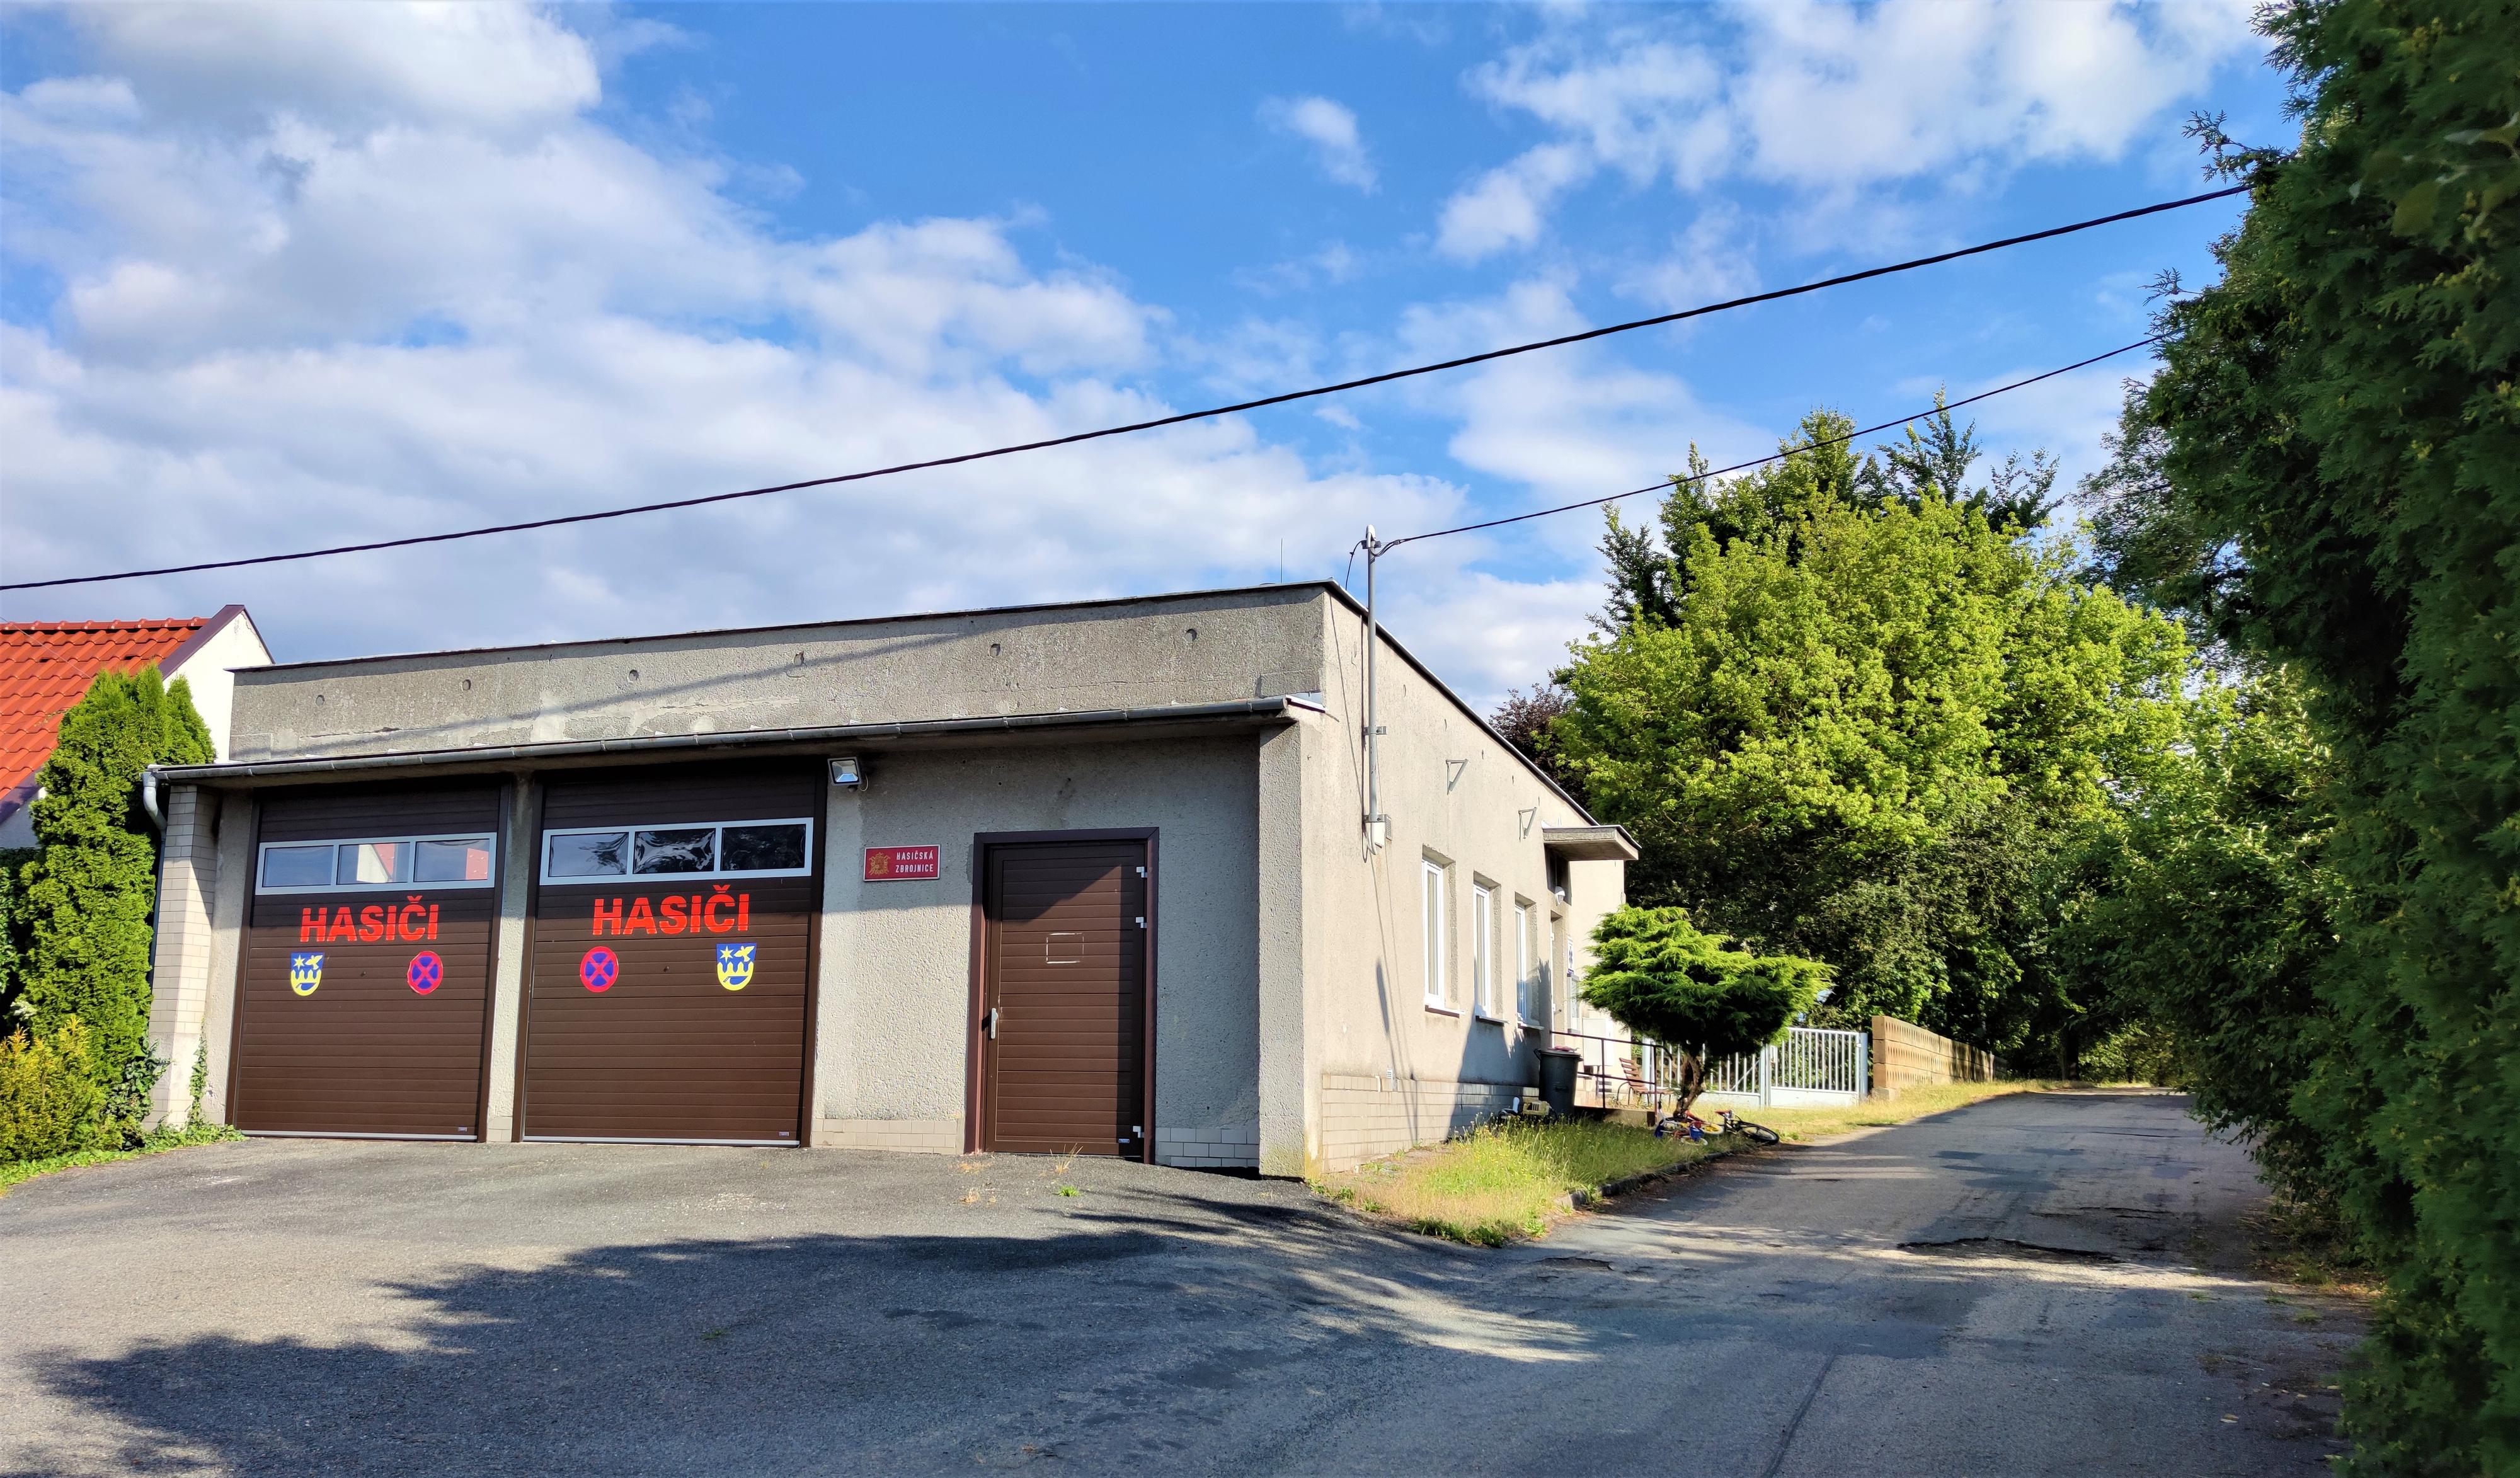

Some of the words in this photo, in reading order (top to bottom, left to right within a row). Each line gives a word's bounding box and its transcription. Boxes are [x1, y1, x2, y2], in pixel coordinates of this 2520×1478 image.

[895, 864, 934, 873] ZBROJNICE
[896, 850, 933, 860] HASIČSKÁ
[299, 895, 439, 942] HASIČI
[592, 885, 749, 935] HASIČI
